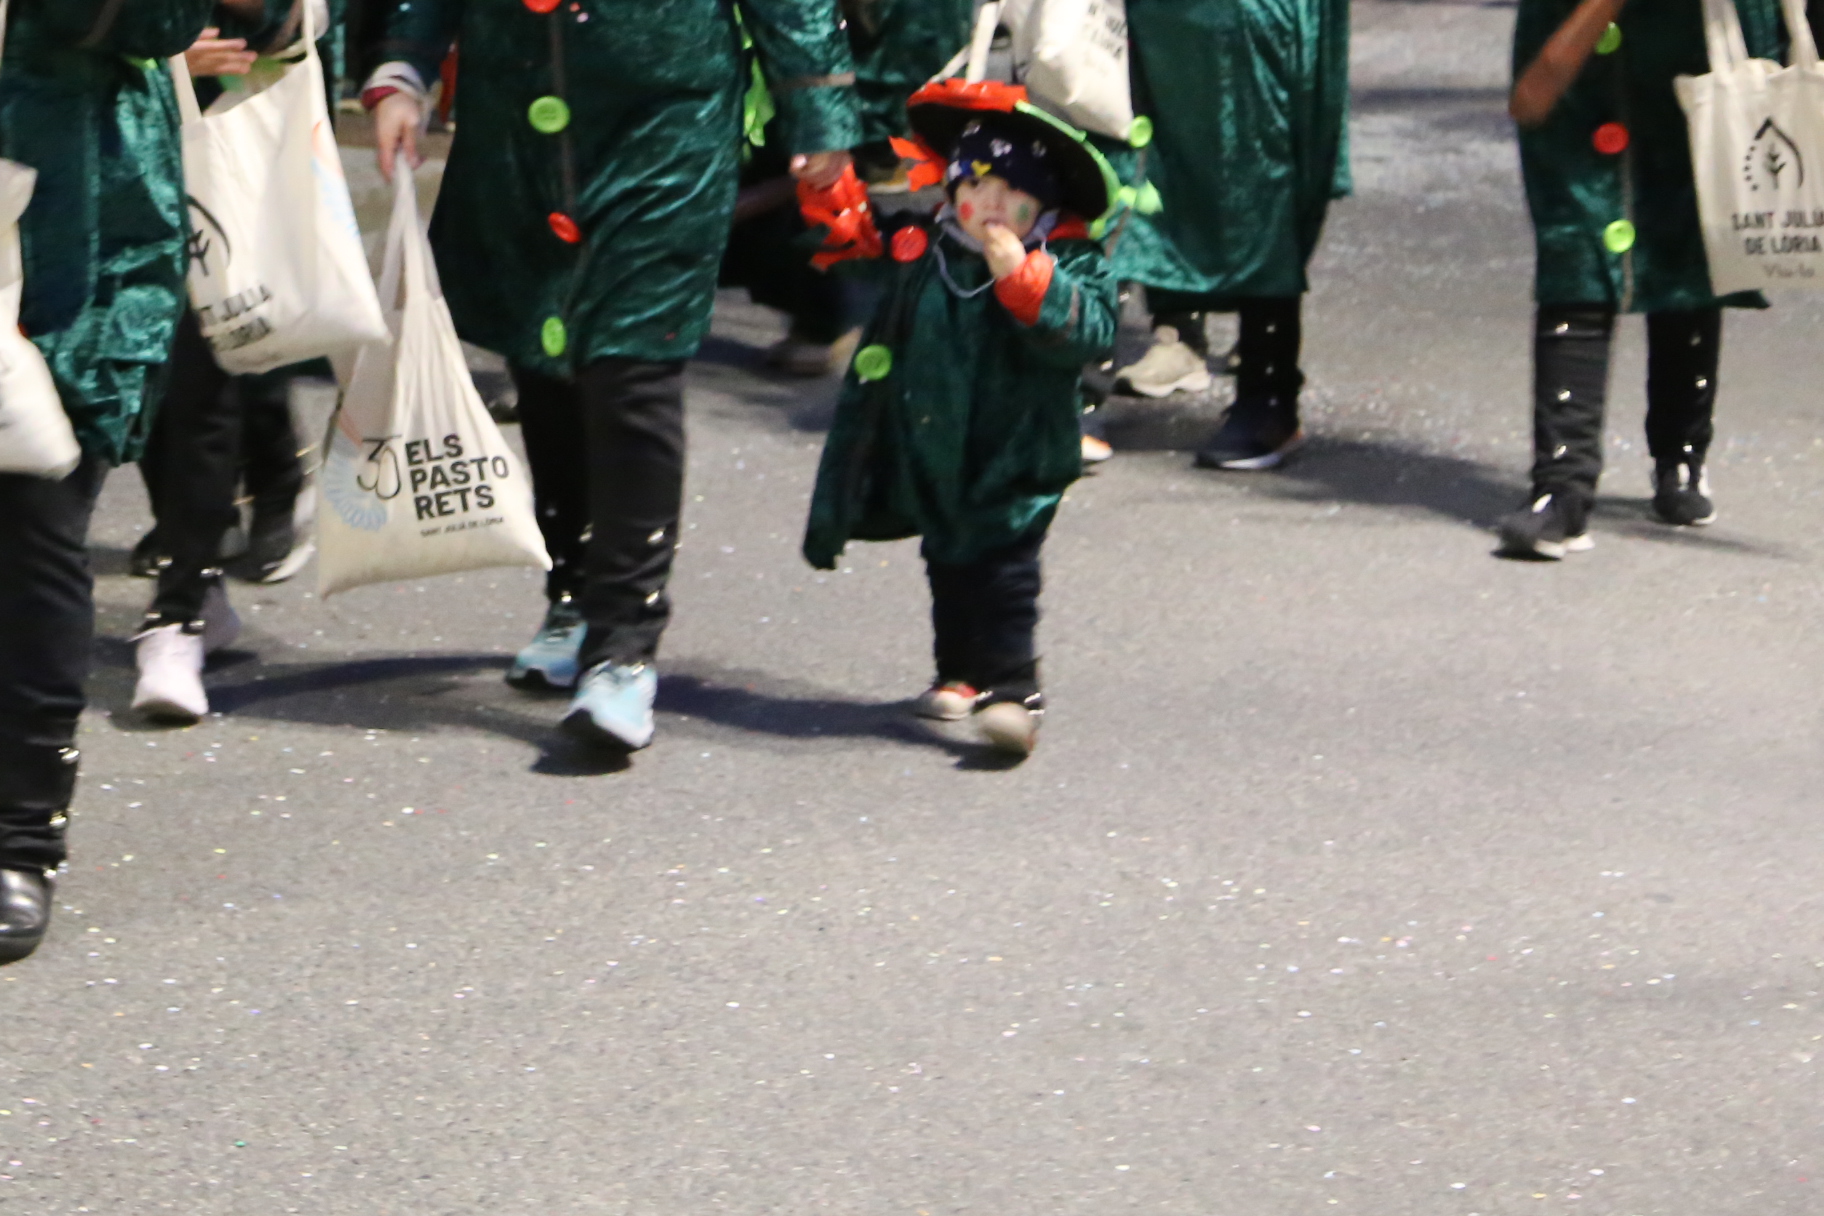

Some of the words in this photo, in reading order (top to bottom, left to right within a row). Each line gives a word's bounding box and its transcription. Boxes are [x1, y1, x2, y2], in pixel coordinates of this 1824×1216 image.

[405, 433, 464, 467] ELS
[410, 455, 510, 494] PASTO
[414, 485, 496, 521] RETS
